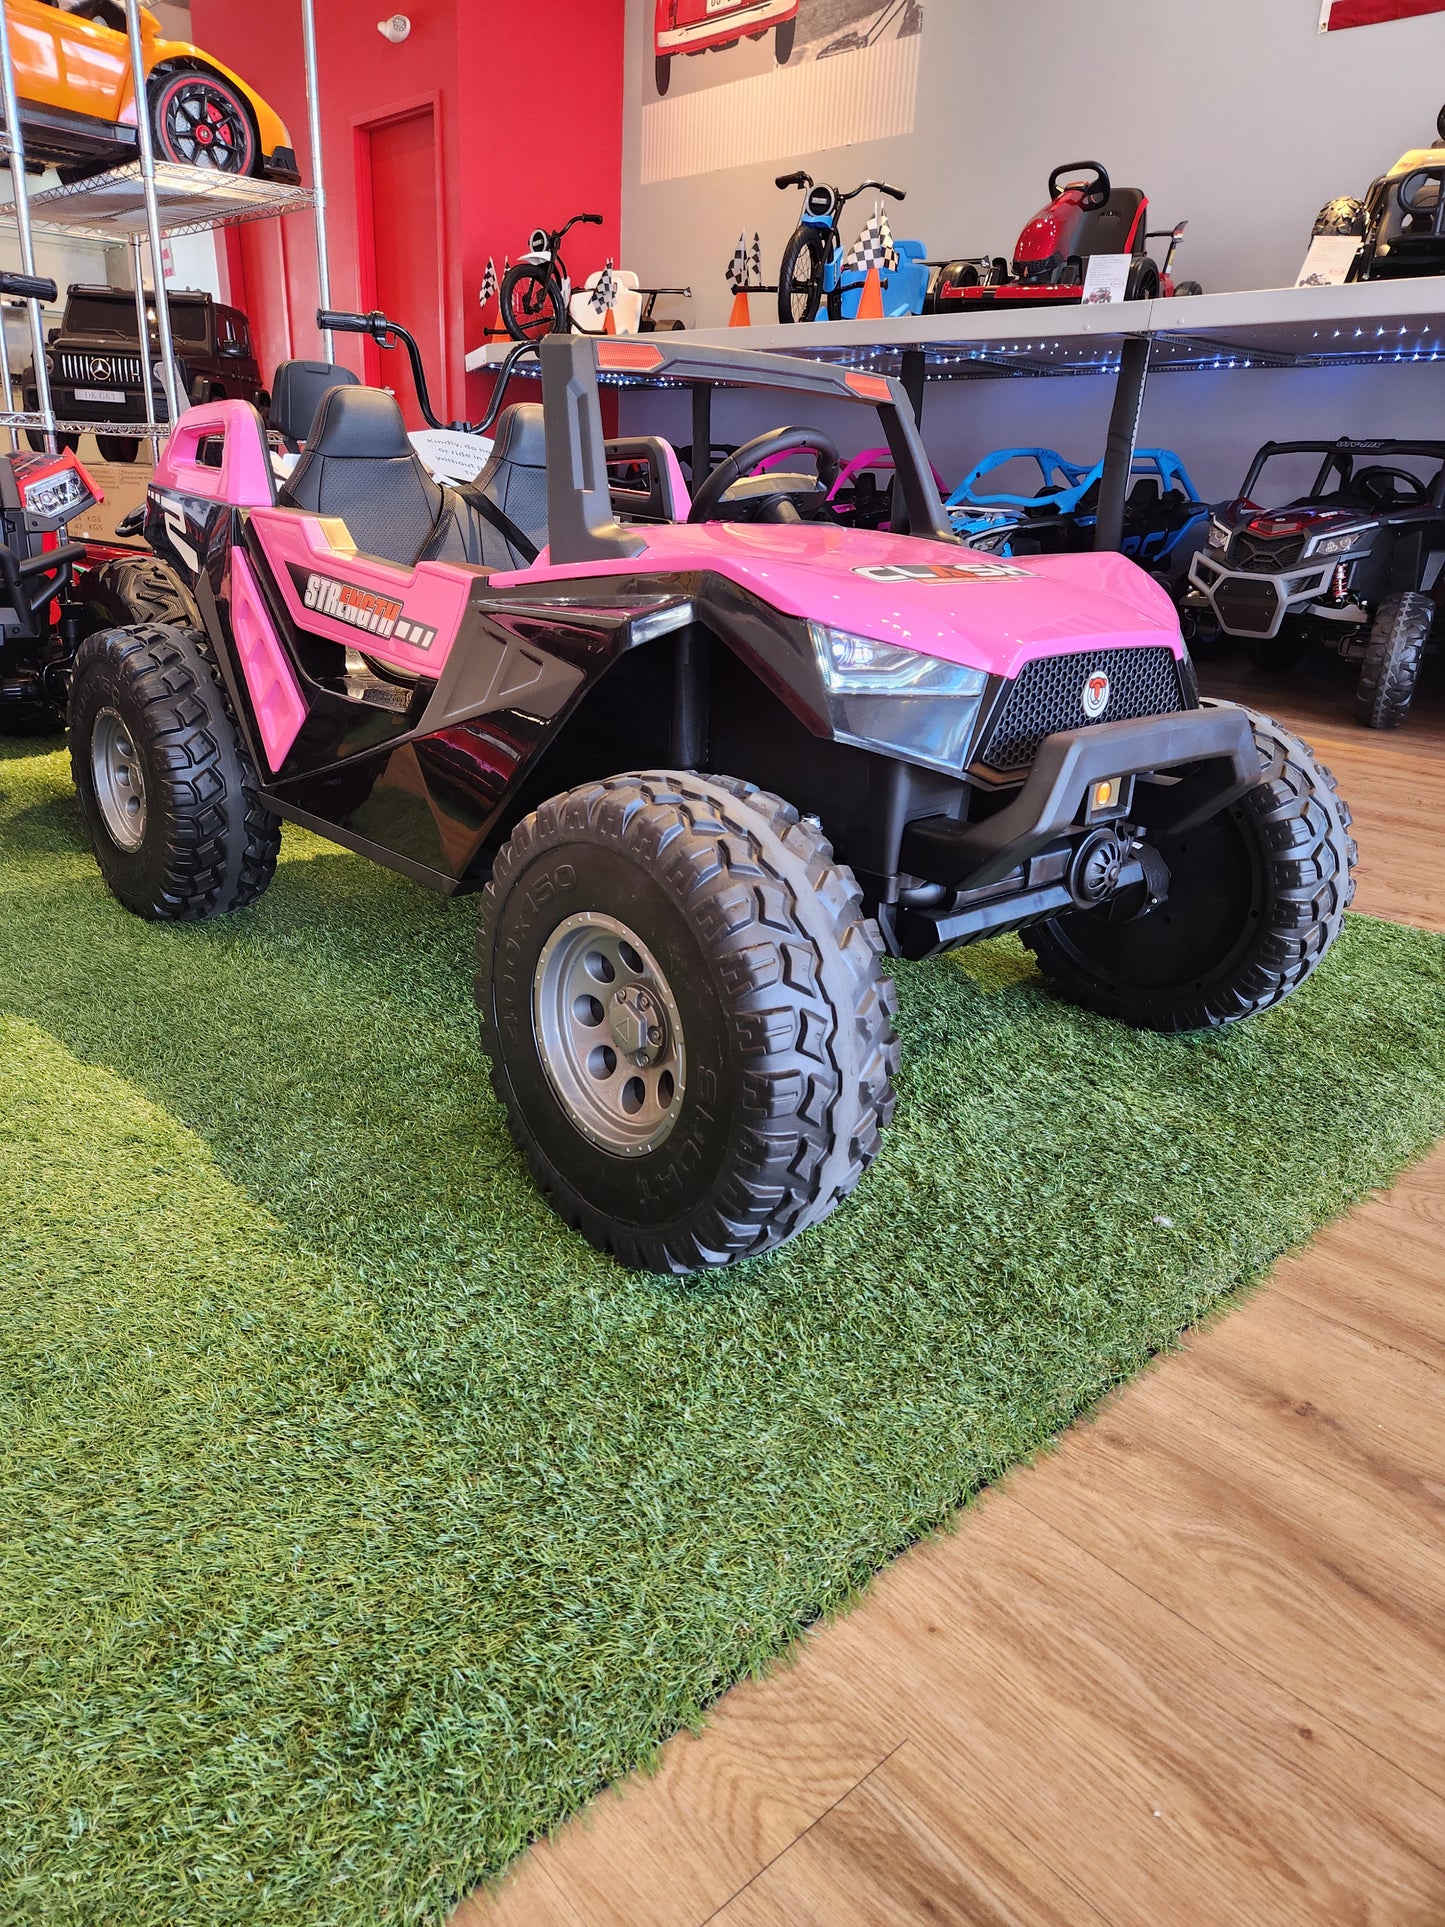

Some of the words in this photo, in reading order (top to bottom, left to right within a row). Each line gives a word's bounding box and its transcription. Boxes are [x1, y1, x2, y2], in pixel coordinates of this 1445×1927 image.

[426, 438, 462, 448] Kindly,
[464, 443, 477, 451] do
[451, 450, 472, 458] ride
[852, 563, 1038, 582] CLASH
[304, 573, 403, 639] STRENGTH
